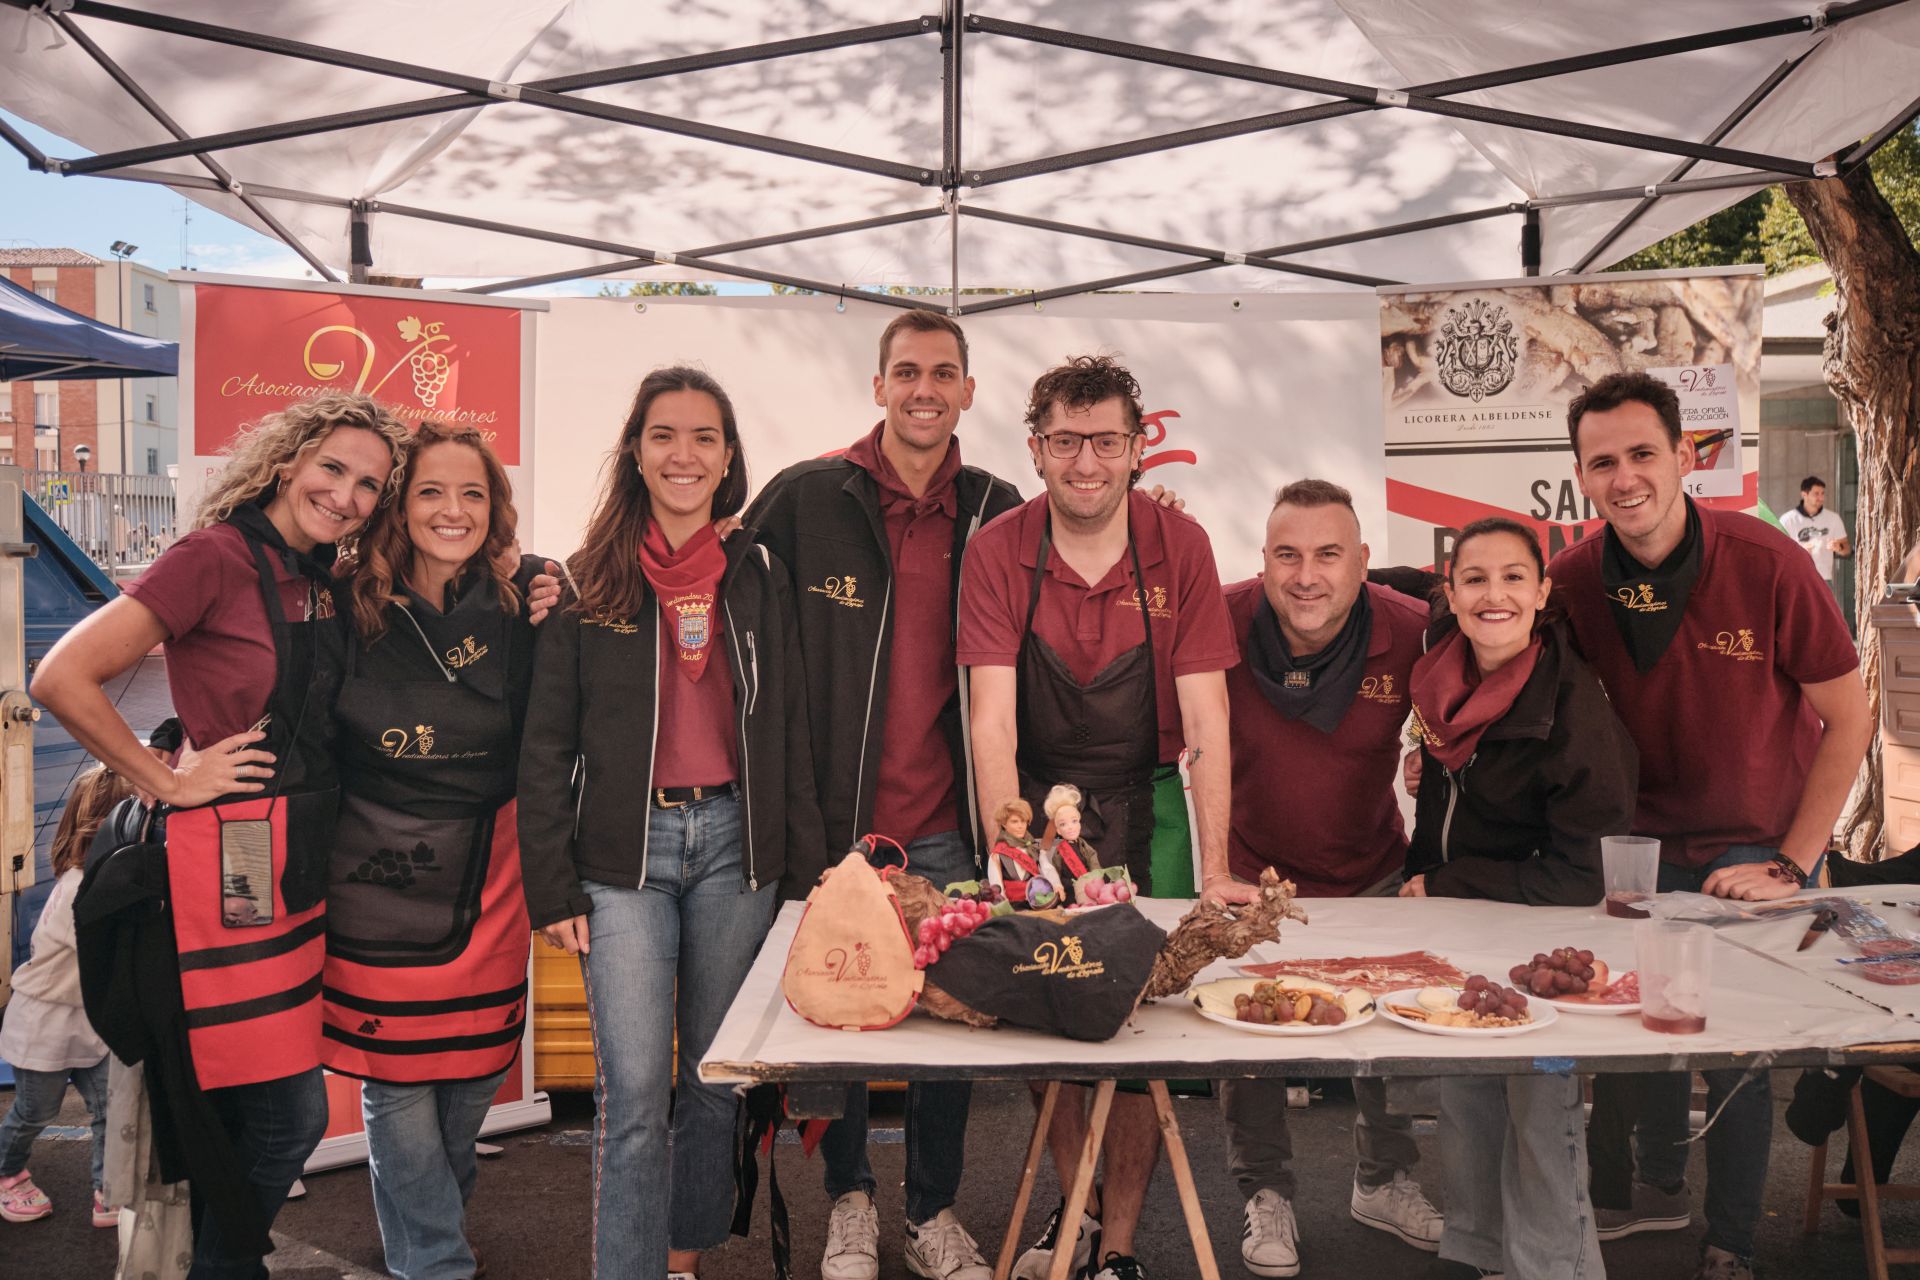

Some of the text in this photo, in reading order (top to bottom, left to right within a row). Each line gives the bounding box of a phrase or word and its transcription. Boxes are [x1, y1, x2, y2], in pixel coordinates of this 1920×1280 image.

[391, 403, 498, 423] dimiadores
[1701, 406, 1727, 414] OFICIAL
[1404, 410, 1553, 424] LICORERA ALBELDENSE
[680, 649, 703, 661] Mart
